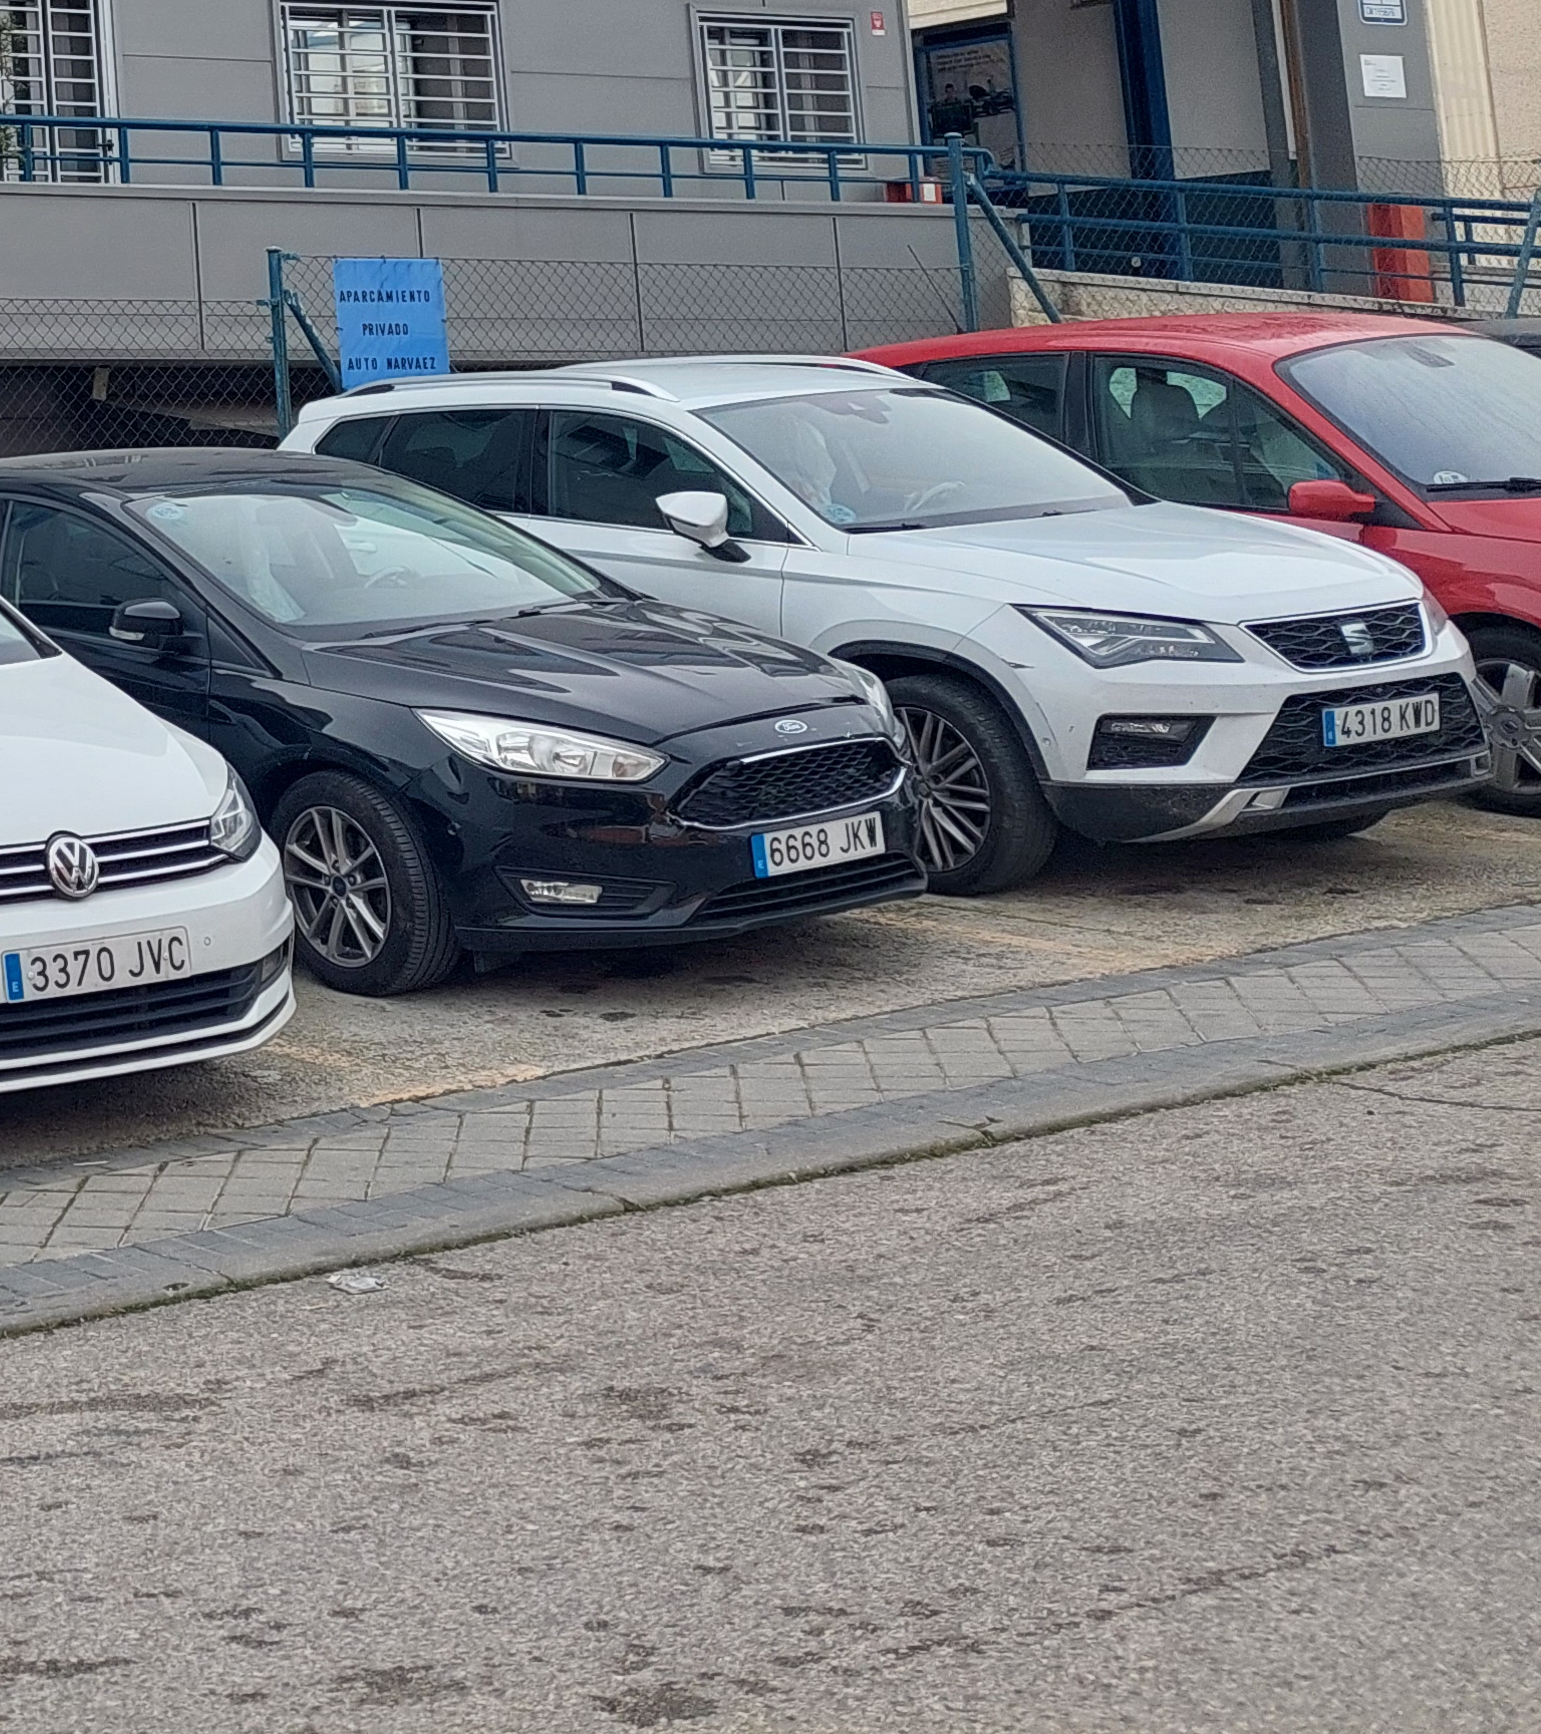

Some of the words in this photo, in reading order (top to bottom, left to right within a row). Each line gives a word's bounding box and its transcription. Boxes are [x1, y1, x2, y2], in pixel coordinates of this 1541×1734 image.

[339, 290, 430, 303] APARCAMIENTO
[362, 323, 409, 336] PRIVADO
[347, 357, 378, 371] AUTO
[386, 356, 436, 370] NARVAEZ
[1341, 706, 1392, 738] 4318
[1399, 699, 1435, 731] KWD
[770, 828, 830, 867] 6668
[840, 817, 877, 853] JKW
[12, 981, 19, 993] E
[30, 946, 116, 992] 3370
[128, 936, 185, 978] JVC
